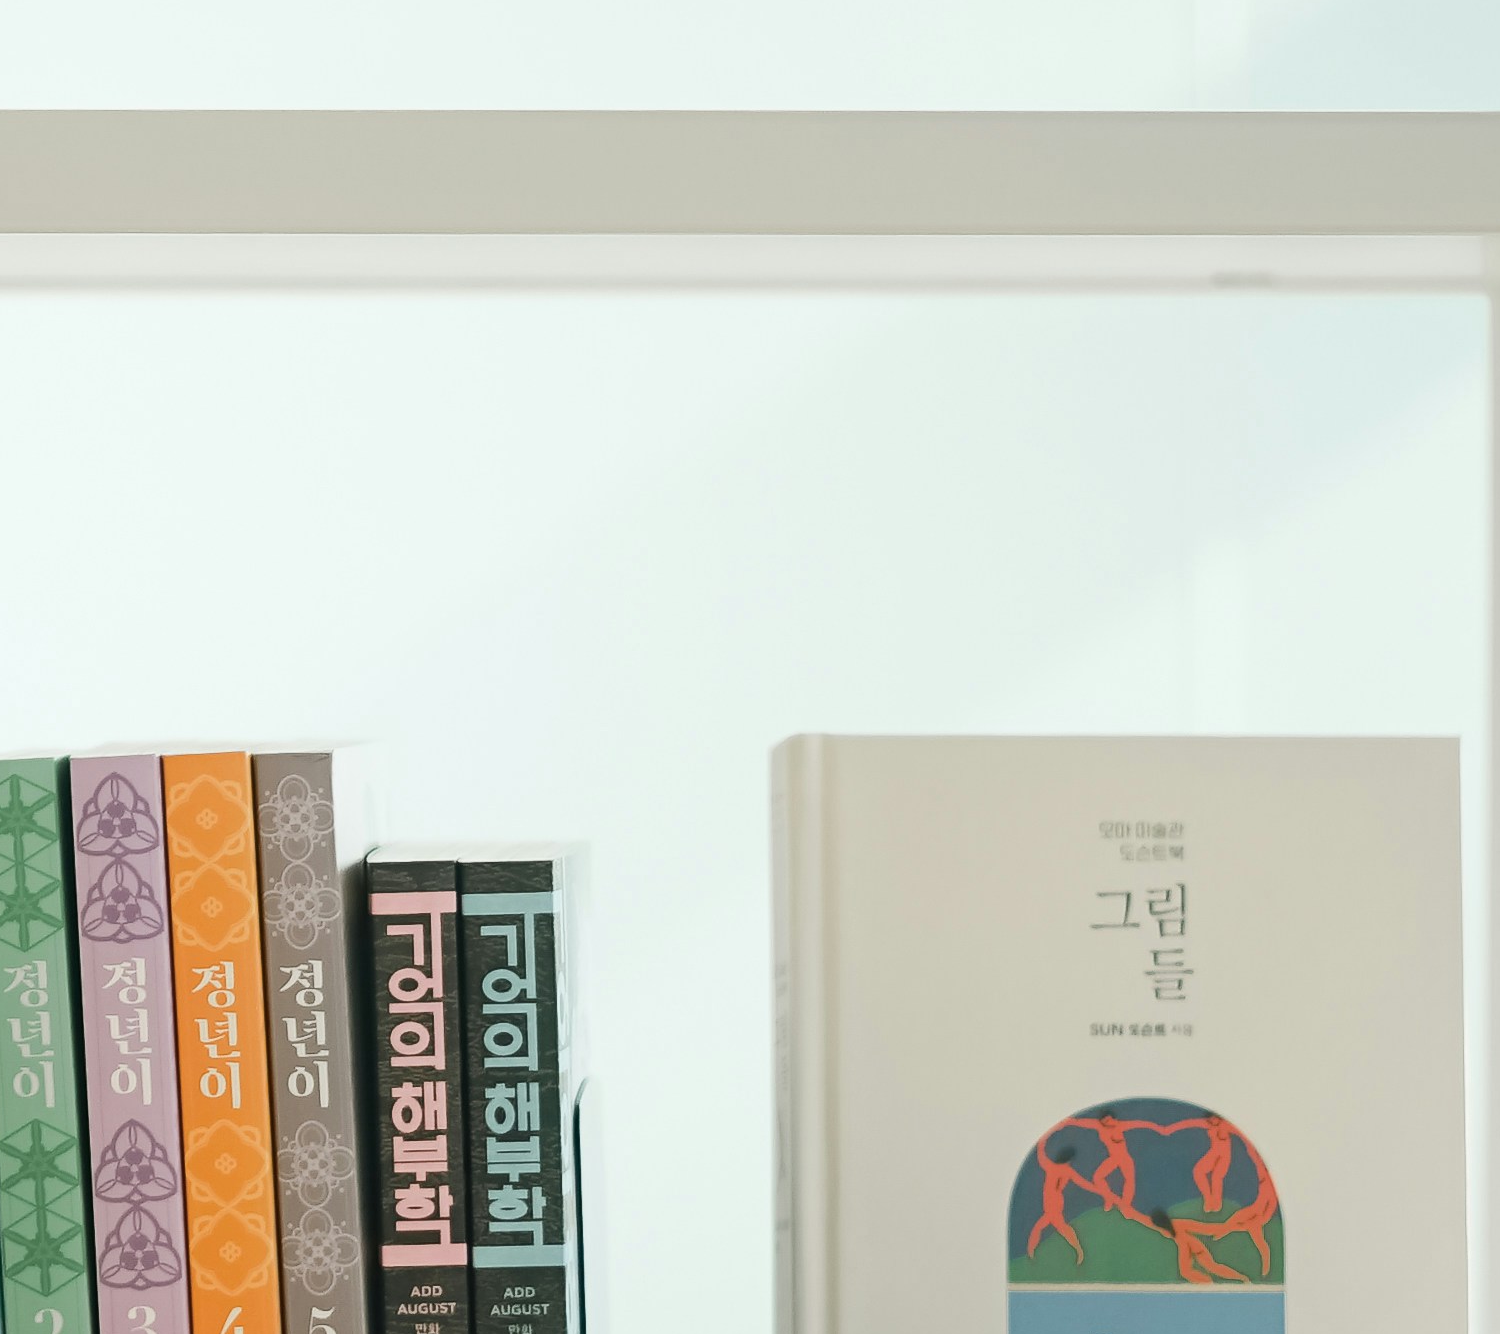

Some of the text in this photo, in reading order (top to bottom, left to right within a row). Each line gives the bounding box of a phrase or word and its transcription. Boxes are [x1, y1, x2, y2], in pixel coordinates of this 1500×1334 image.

[1090, 882, 1186, 938] 그림
[1143, 948, 1194, 1001] 들
[3, 959, 55, 1109] 정년이
[101, 956, 153, 1107] 정년이
[191, 959, 242, 1110] 정년이
[279, 959, 331, 1110] 정년이
[385, 917, 447, 1071] 기억의
[479, 917, 539, 1072] 기억의
[391, 1080, 454, 1244] 해부학
[485, 1081, 547, 1245] 해부학
[397, 1302, 457, 1315] AUGUST
[410, 1285, 443, 1298] ADD
